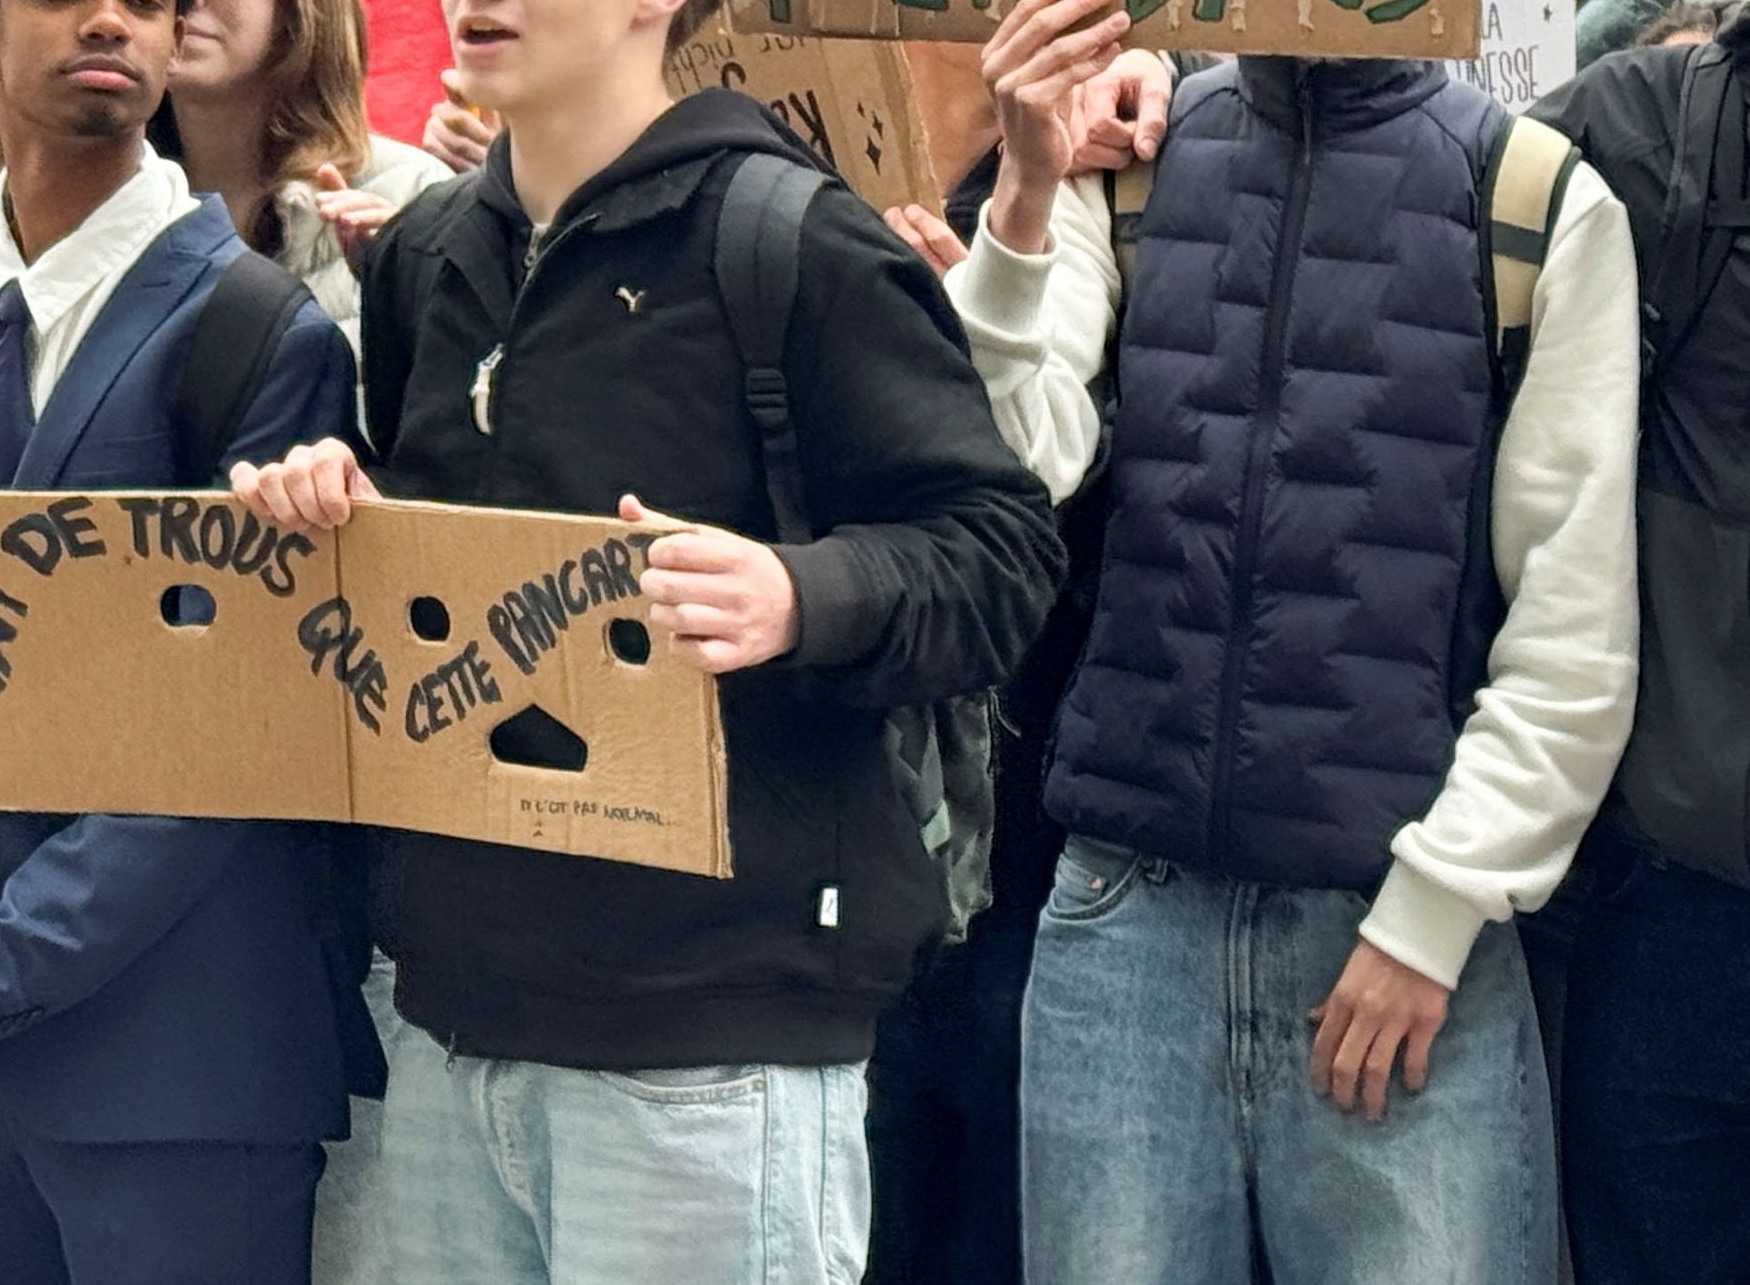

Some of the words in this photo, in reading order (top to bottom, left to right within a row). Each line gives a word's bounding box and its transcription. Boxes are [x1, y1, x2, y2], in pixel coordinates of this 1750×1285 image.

[0, 496, 107, 576] DE
[117, 496, 317, 598] TROUS
[297, 597, 389, 737] QUE
